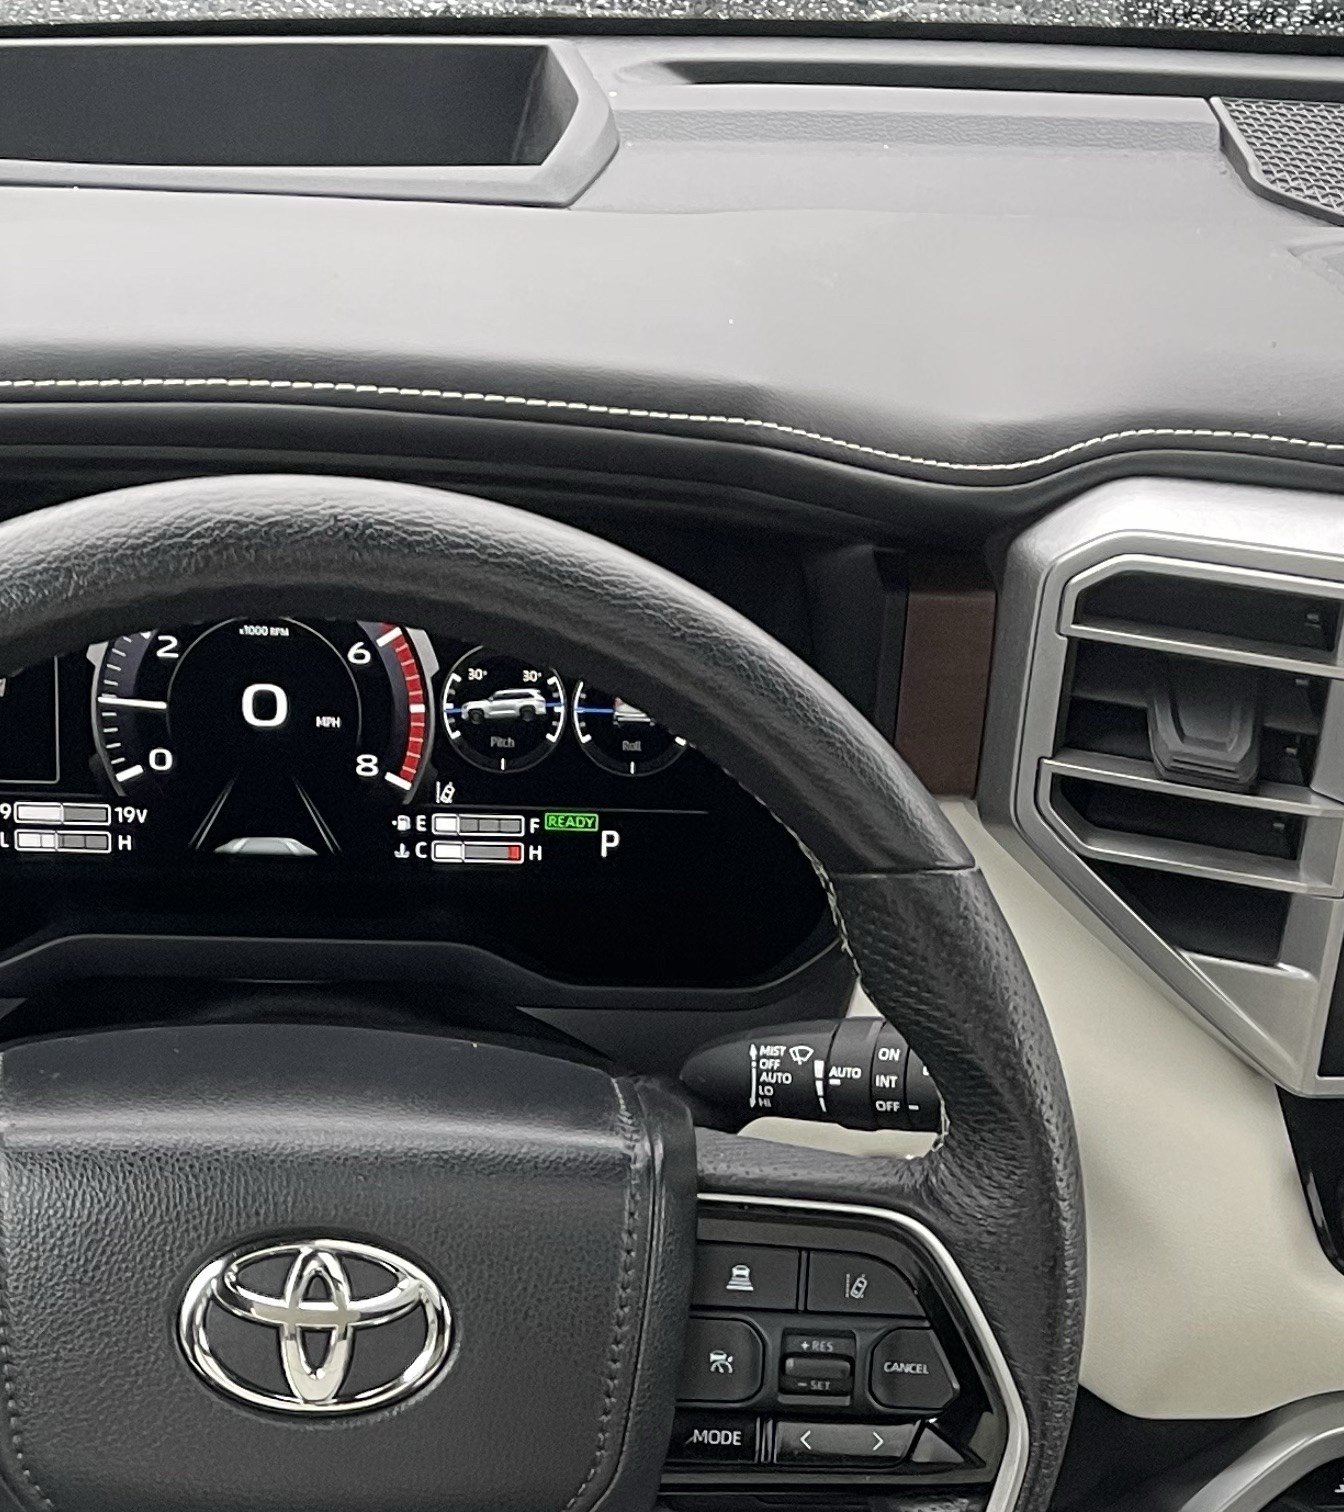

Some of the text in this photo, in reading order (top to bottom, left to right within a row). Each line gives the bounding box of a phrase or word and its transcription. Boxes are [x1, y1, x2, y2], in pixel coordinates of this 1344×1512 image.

[269, 627, 289, 638] RPM
[157, 635, 179, 658] 2
[347, 641, 371, 665] 6
[241, 683, 288, 727] 0
[315, 716, 341, 729] MPH
[490, 736, 516, 750] Pitch
[149, 748, 173, 771] 0
[356, 753, 380, 778] 8
[114, 808, 148, 824] 19V
[547, 815, 596, 829] READY
[416, 818, 541, 834] E F
[0, 832, 133, 851] L H
[600, 830, 621, 858] P
[415, 842, 543, 861] C H
[759, 1046, 786, 1057] MIST
[878, 1048, 900, 1061] ON
[759, 1059, 780, 1069] OFF
[759, 1073, 792, 1084] AUTO
[828, 1067, 862, 1079] AUTO
[875, 1075, 898, 1089] INT
[759, 1086, 774, 1096] LO
[875, 1101, 901, 1112] OFF
[883, 1361, 929, 1375] CANCEL
[692, 1429, 742, 1446] MODE
